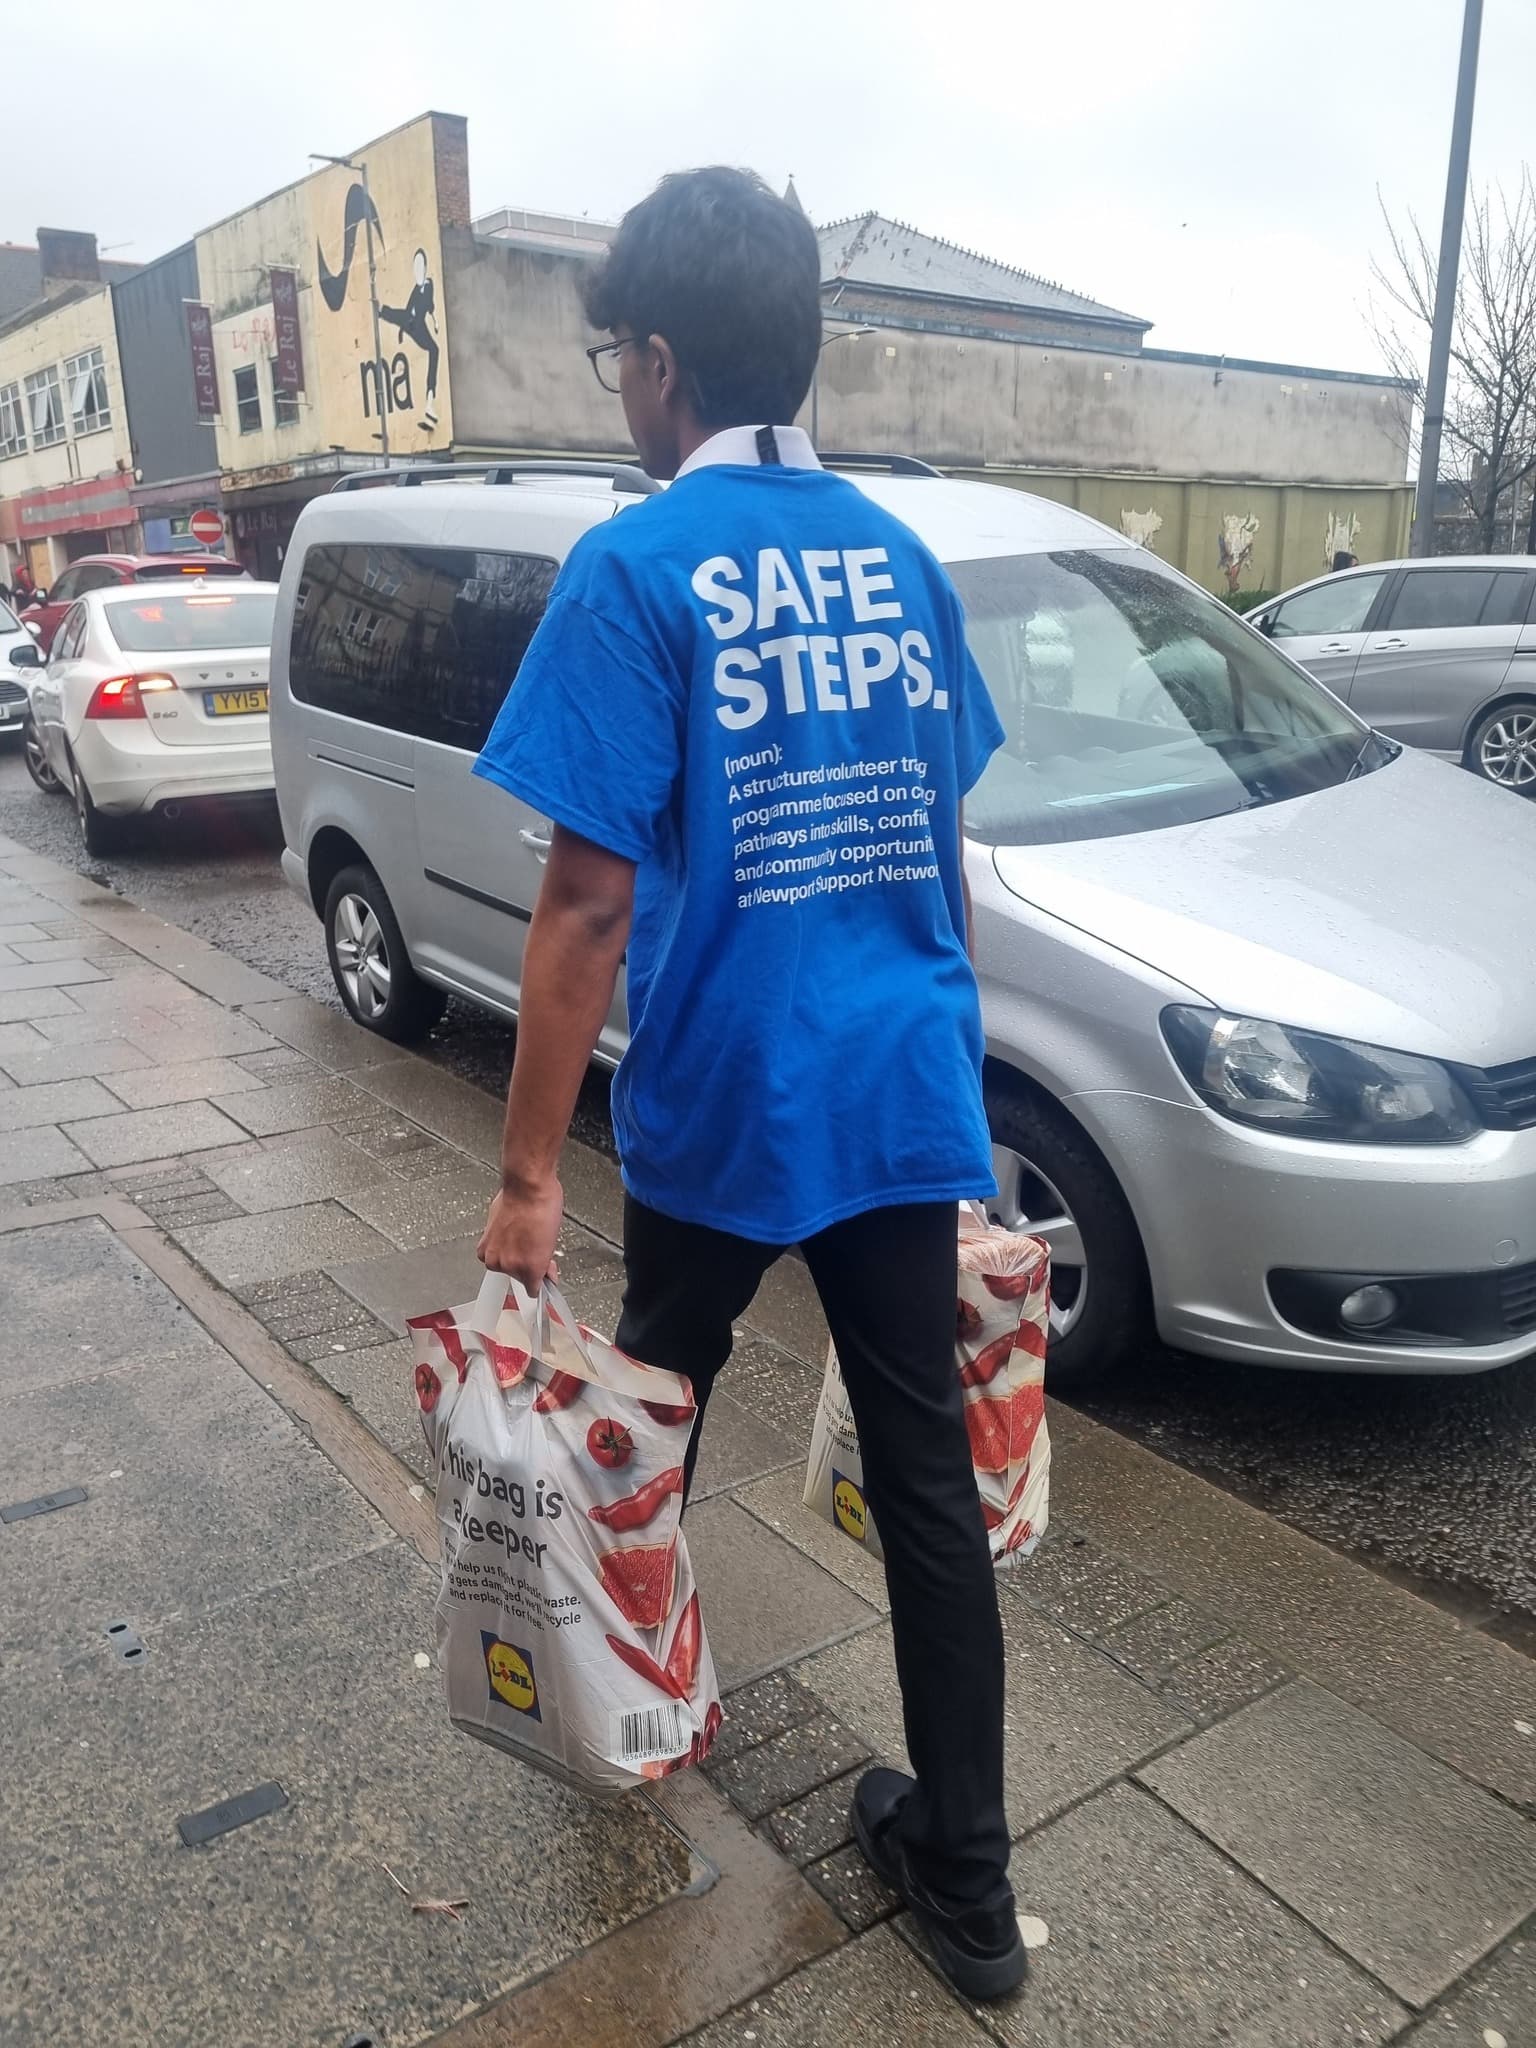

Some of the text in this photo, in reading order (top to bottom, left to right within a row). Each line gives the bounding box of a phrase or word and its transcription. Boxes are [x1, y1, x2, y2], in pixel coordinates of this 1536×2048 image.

[277, 316, 298, 383] Le Raj
[193, 346, 215, 406] Le Raj
[691, 548, 903, 640] SAFE
[219, 692, 260, 709] YY15
[713, 629, 949, 730] STEPS.
[724, 743, 783, 779] (noun):
[728, 785, 741, 804] A
[742, 764, 824, 798] structured
[825, 759, 898, 781] volunteer
[732, 798, 821, 834] programme
[823, 785, 878, 811] focused
[883, 786, 907, 802] on
[734, 827, 807, 860] pathways
[810, 823, 830, 841] into
[831, 814, 874, 836] skills,
[735, 860, 764, 882] and
[765, 847, 837, 875] community
[738, 893, 753, 909] at
[752, 880, 816, 905] Newport
[816, 868, 874, 892] Support
[477, 1458, 526, 1519] bag
[536, 1479, 564, 1520] is
[453, 1498, 463, 1524] a
[457, 1576, 479, 1588] gets
[458, 1560, 481, 1576] help
[483, 1564, 496, 1575] us
[449, 1587, 466, 1601] and
[511, 1605, 526, 1618] for
